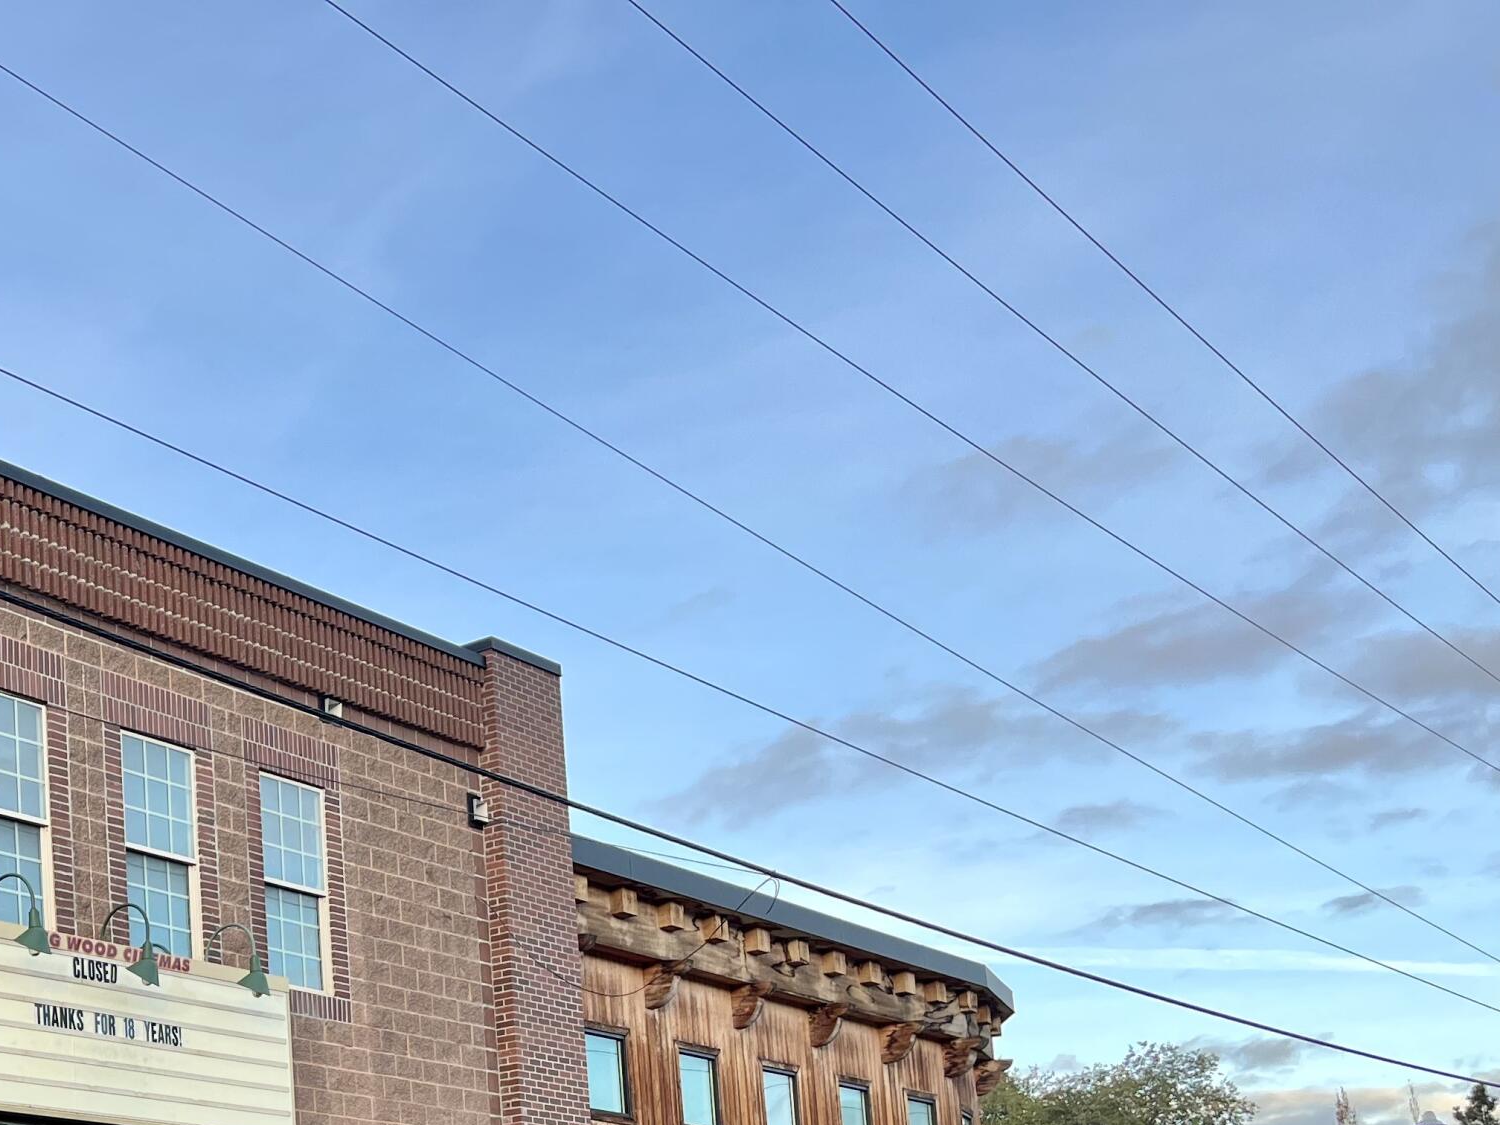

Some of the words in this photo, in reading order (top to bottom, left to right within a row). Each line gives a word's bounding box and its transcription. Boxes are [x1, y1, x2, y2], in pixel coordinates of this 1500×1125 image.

[67, 937, 118, 957] WOOD
[123, 949, 190, 972] CIMAS
[73, 957, 118, 984] CLOSED
[34, 1003, 84, 1031] THANKS
[94, 1012, 116, 1036] FOR
[123, 1018, 135, 1040] 18
[144, 1021, 182, 1047] YEARS!
